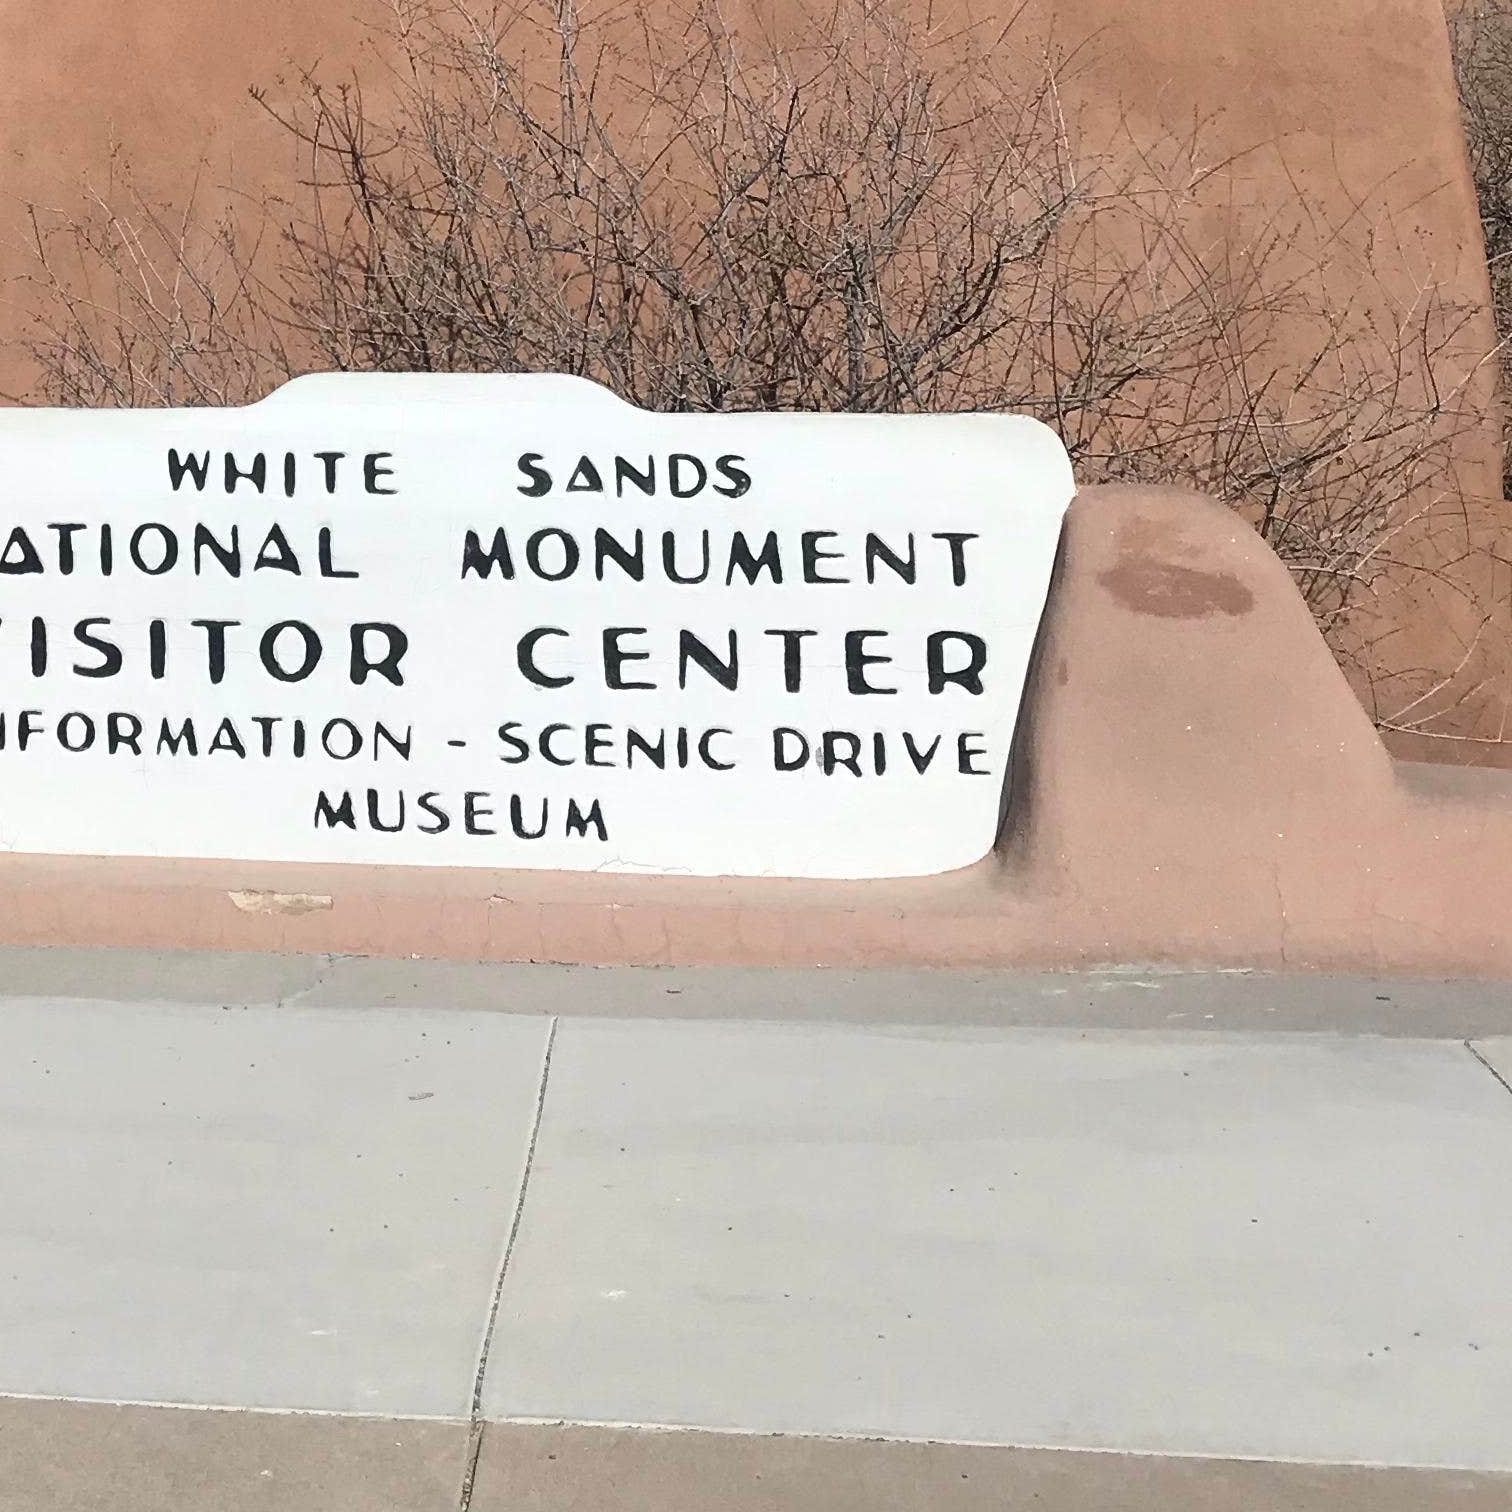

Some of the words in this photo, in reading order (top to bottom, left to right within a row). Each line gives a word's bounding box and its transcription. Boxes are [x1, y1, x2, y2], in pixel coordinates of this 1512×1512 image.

[166, 447, 398, 496] WHITE
[515, 451, 753, 500] SANDS
[460, 525, 981, 588] MONUMENT
[515, 626, 988, 697] CENTER
[497, 720, 737, 772] SCENIC
[771, 726, 993, 778] DRIVE
[313, 787, 610, 843] MUSEUM
